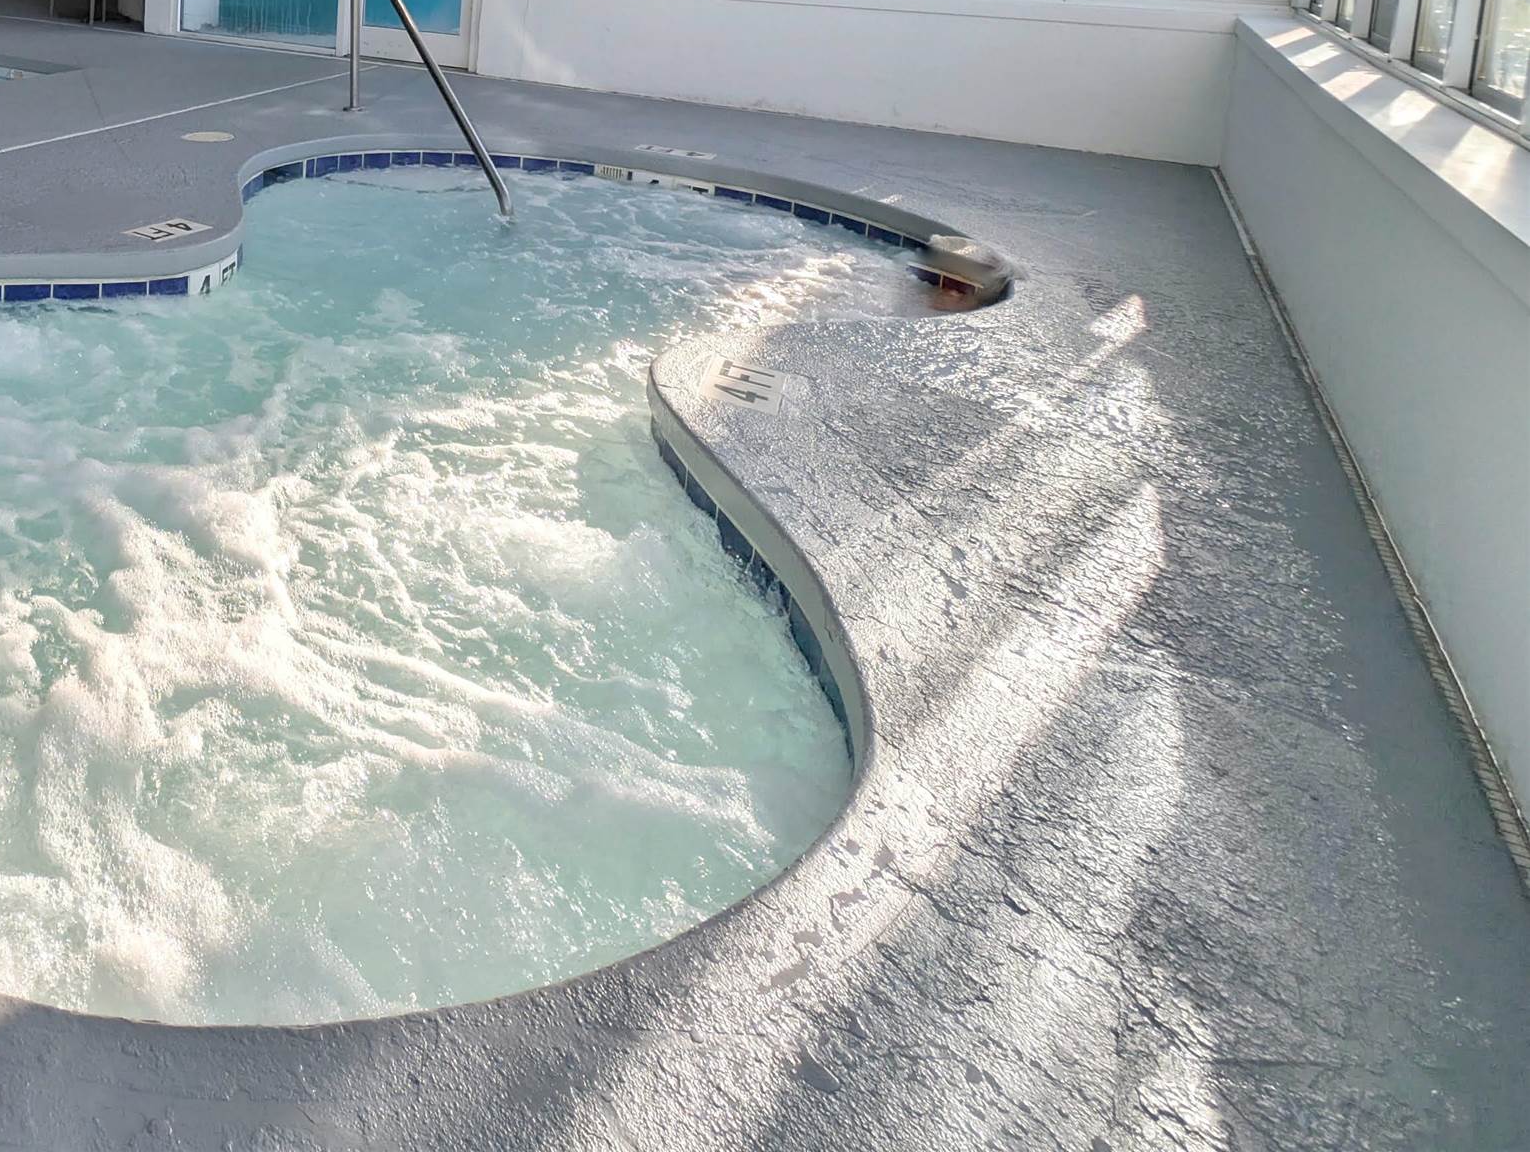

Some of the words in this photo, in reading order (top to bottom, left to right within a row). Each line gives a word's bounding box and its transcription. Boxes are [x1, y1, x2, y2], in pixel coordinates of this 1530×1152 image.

[131, 227, 175, 240] FT
[165, 222, 192, 231] 4
[718, 359, 775, 388] FT
[714, 383, 769, 403] 4
